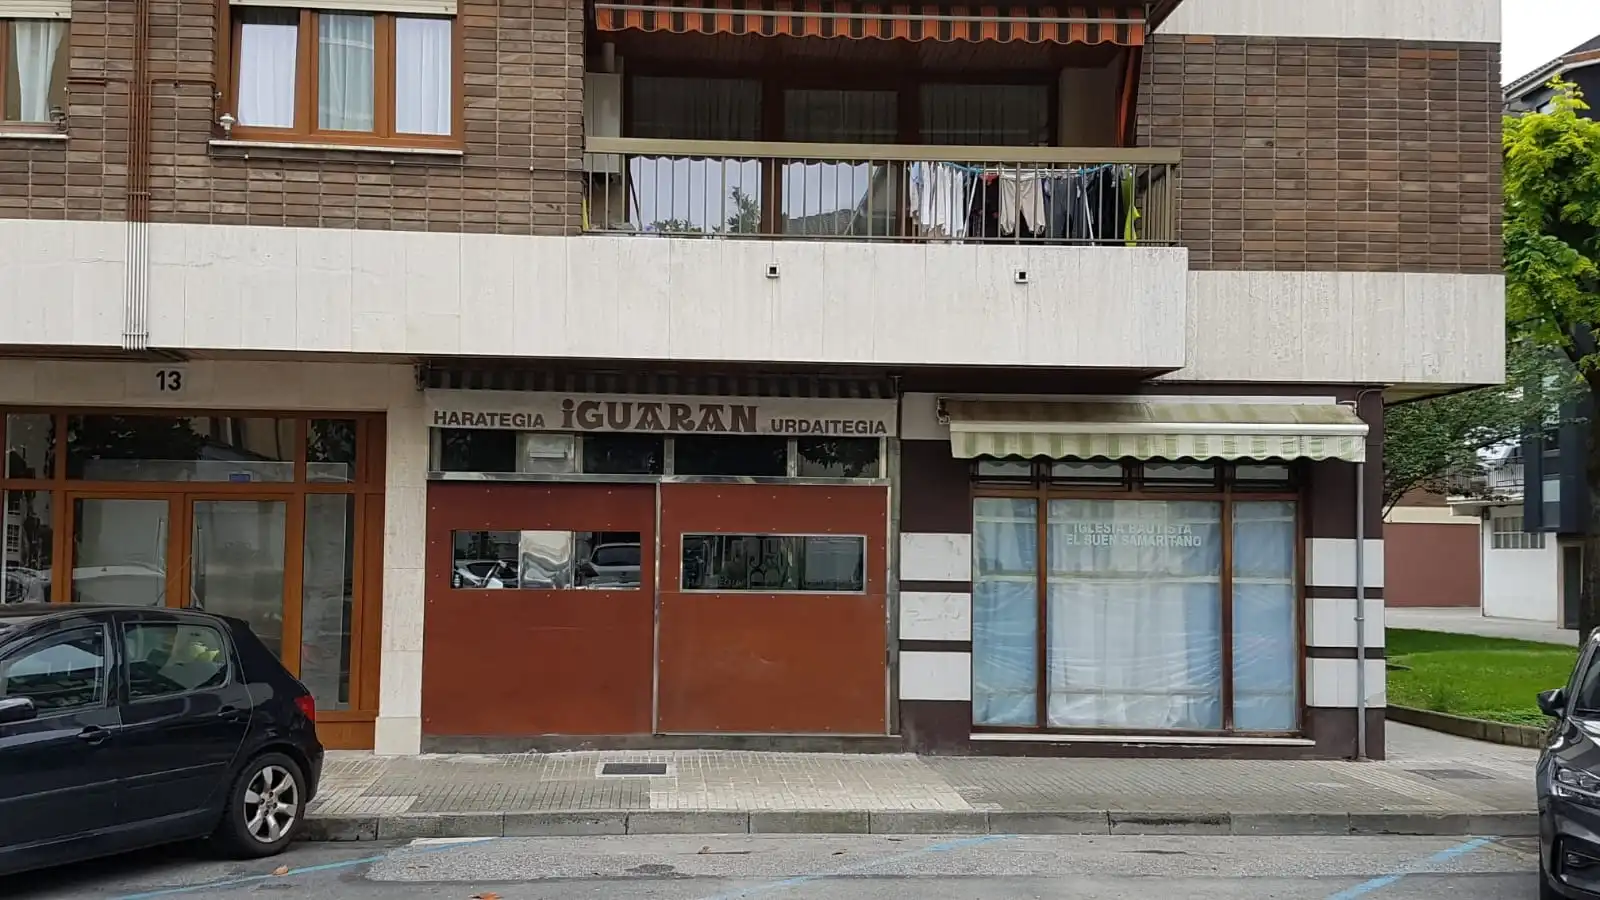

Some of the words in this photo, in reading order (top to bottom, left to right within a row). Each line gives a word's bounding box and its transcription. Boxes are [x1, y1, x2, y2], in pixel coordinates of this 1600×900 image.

[155, 370, 182, 391] 13
[433, 410, 546, 428] HARATEGIA
[1074, 523, 1124, 534] IGLESIA
[1066, 533, 1081, 546] EL
[1084, 534, 1117, 546] BUEN
[1122, 535, 1202, 547] SAMARITANO
